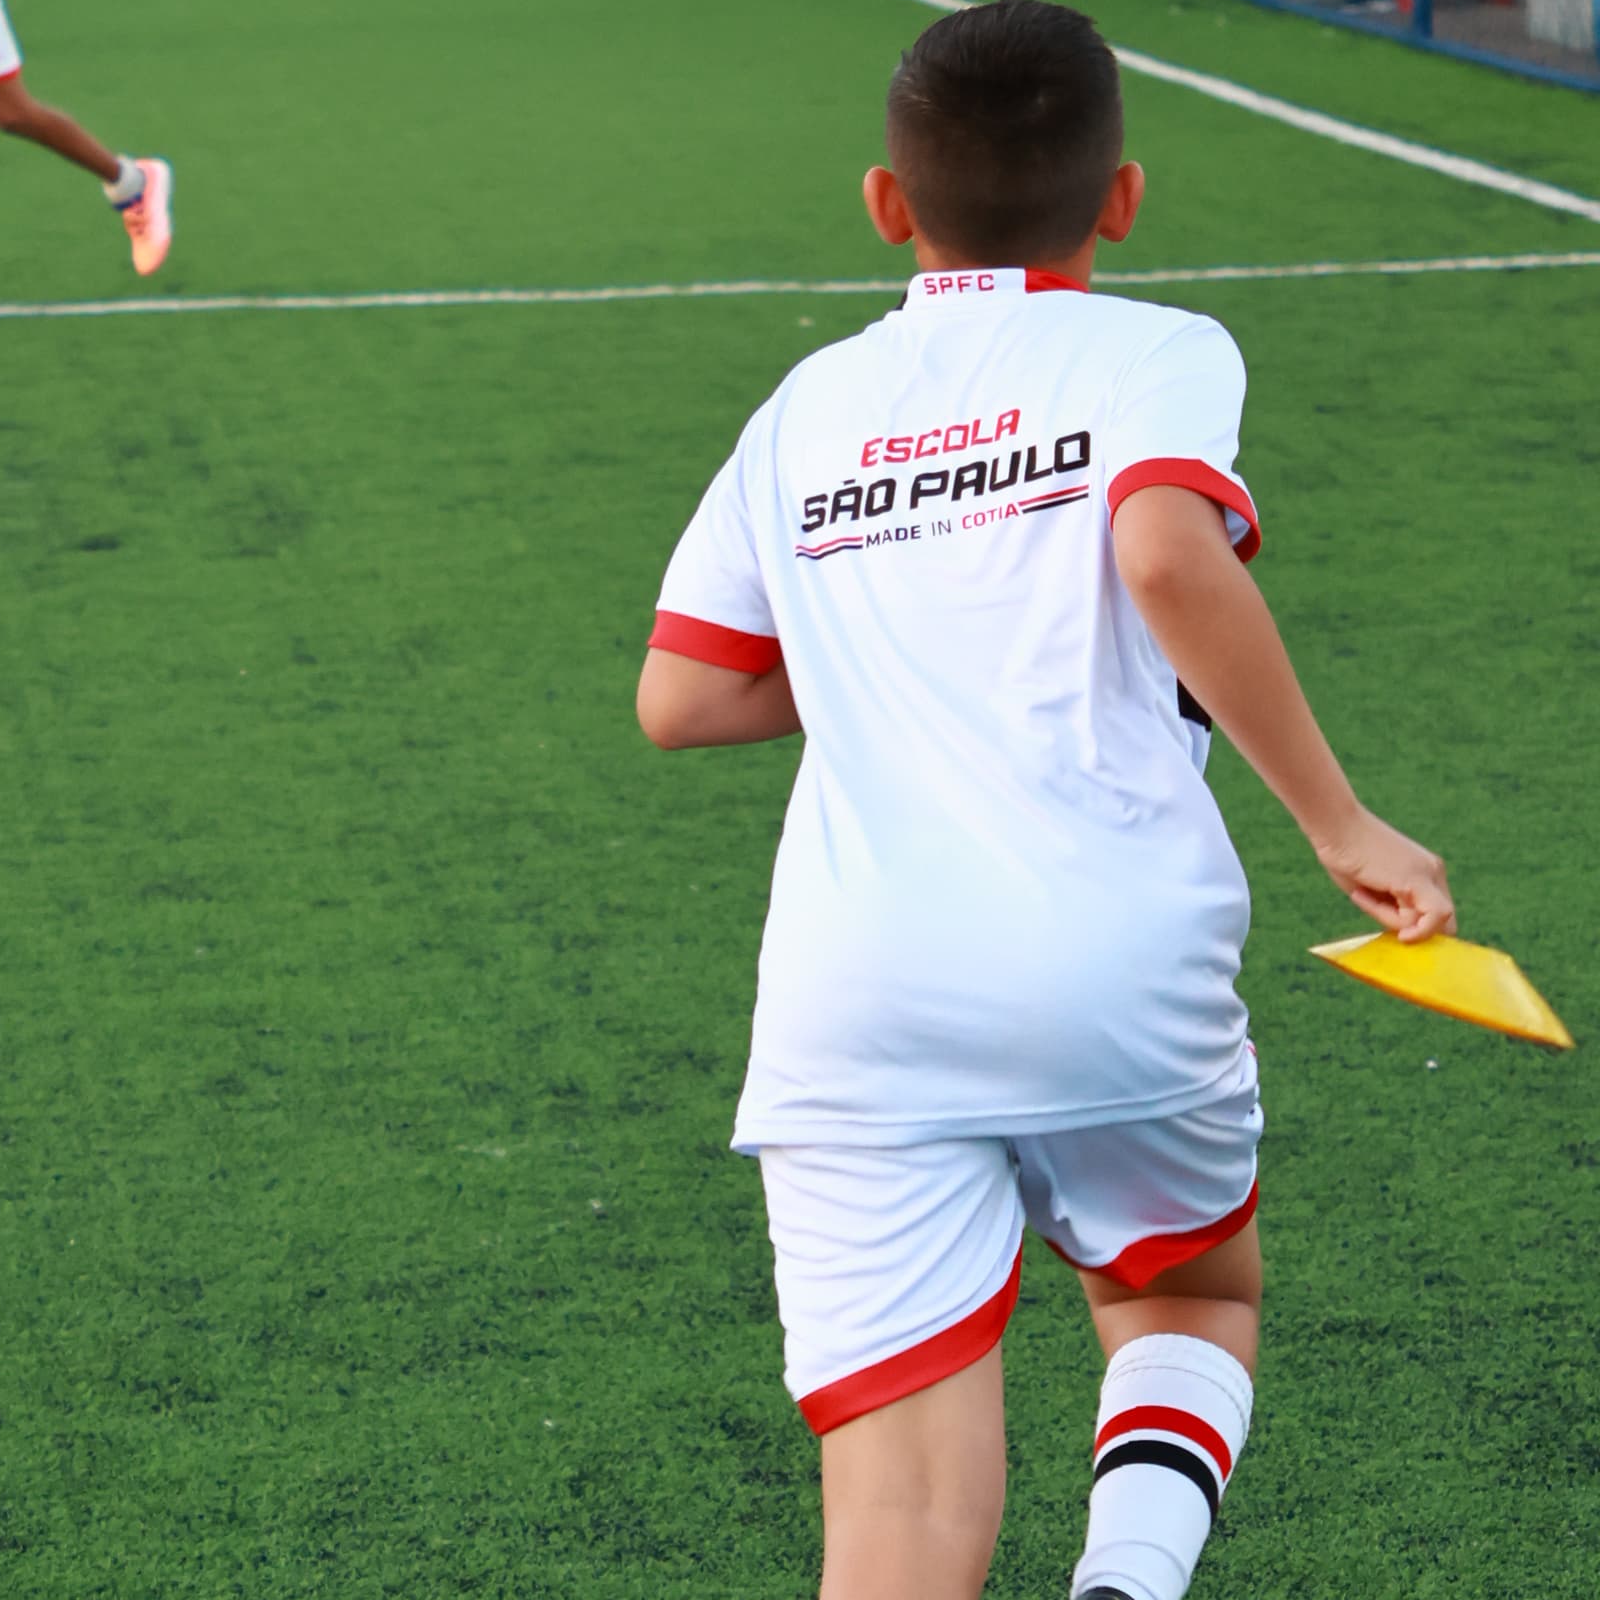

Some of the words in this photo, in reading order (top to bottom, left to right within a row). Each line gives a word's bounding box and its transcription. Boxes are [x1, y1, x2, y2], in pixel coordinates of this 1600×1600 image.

[923, 273, 996, 295] SPFC
[860, 408, 1021, 468] ESCOLA
[801, 478, 897, 533] SÃO
[909, 430, 1091, 510] PAULO
[865, 525, 922, 548] MADE
[931, 519, 952, 536] IN
[961, 503, 1020, 530] COTIA
